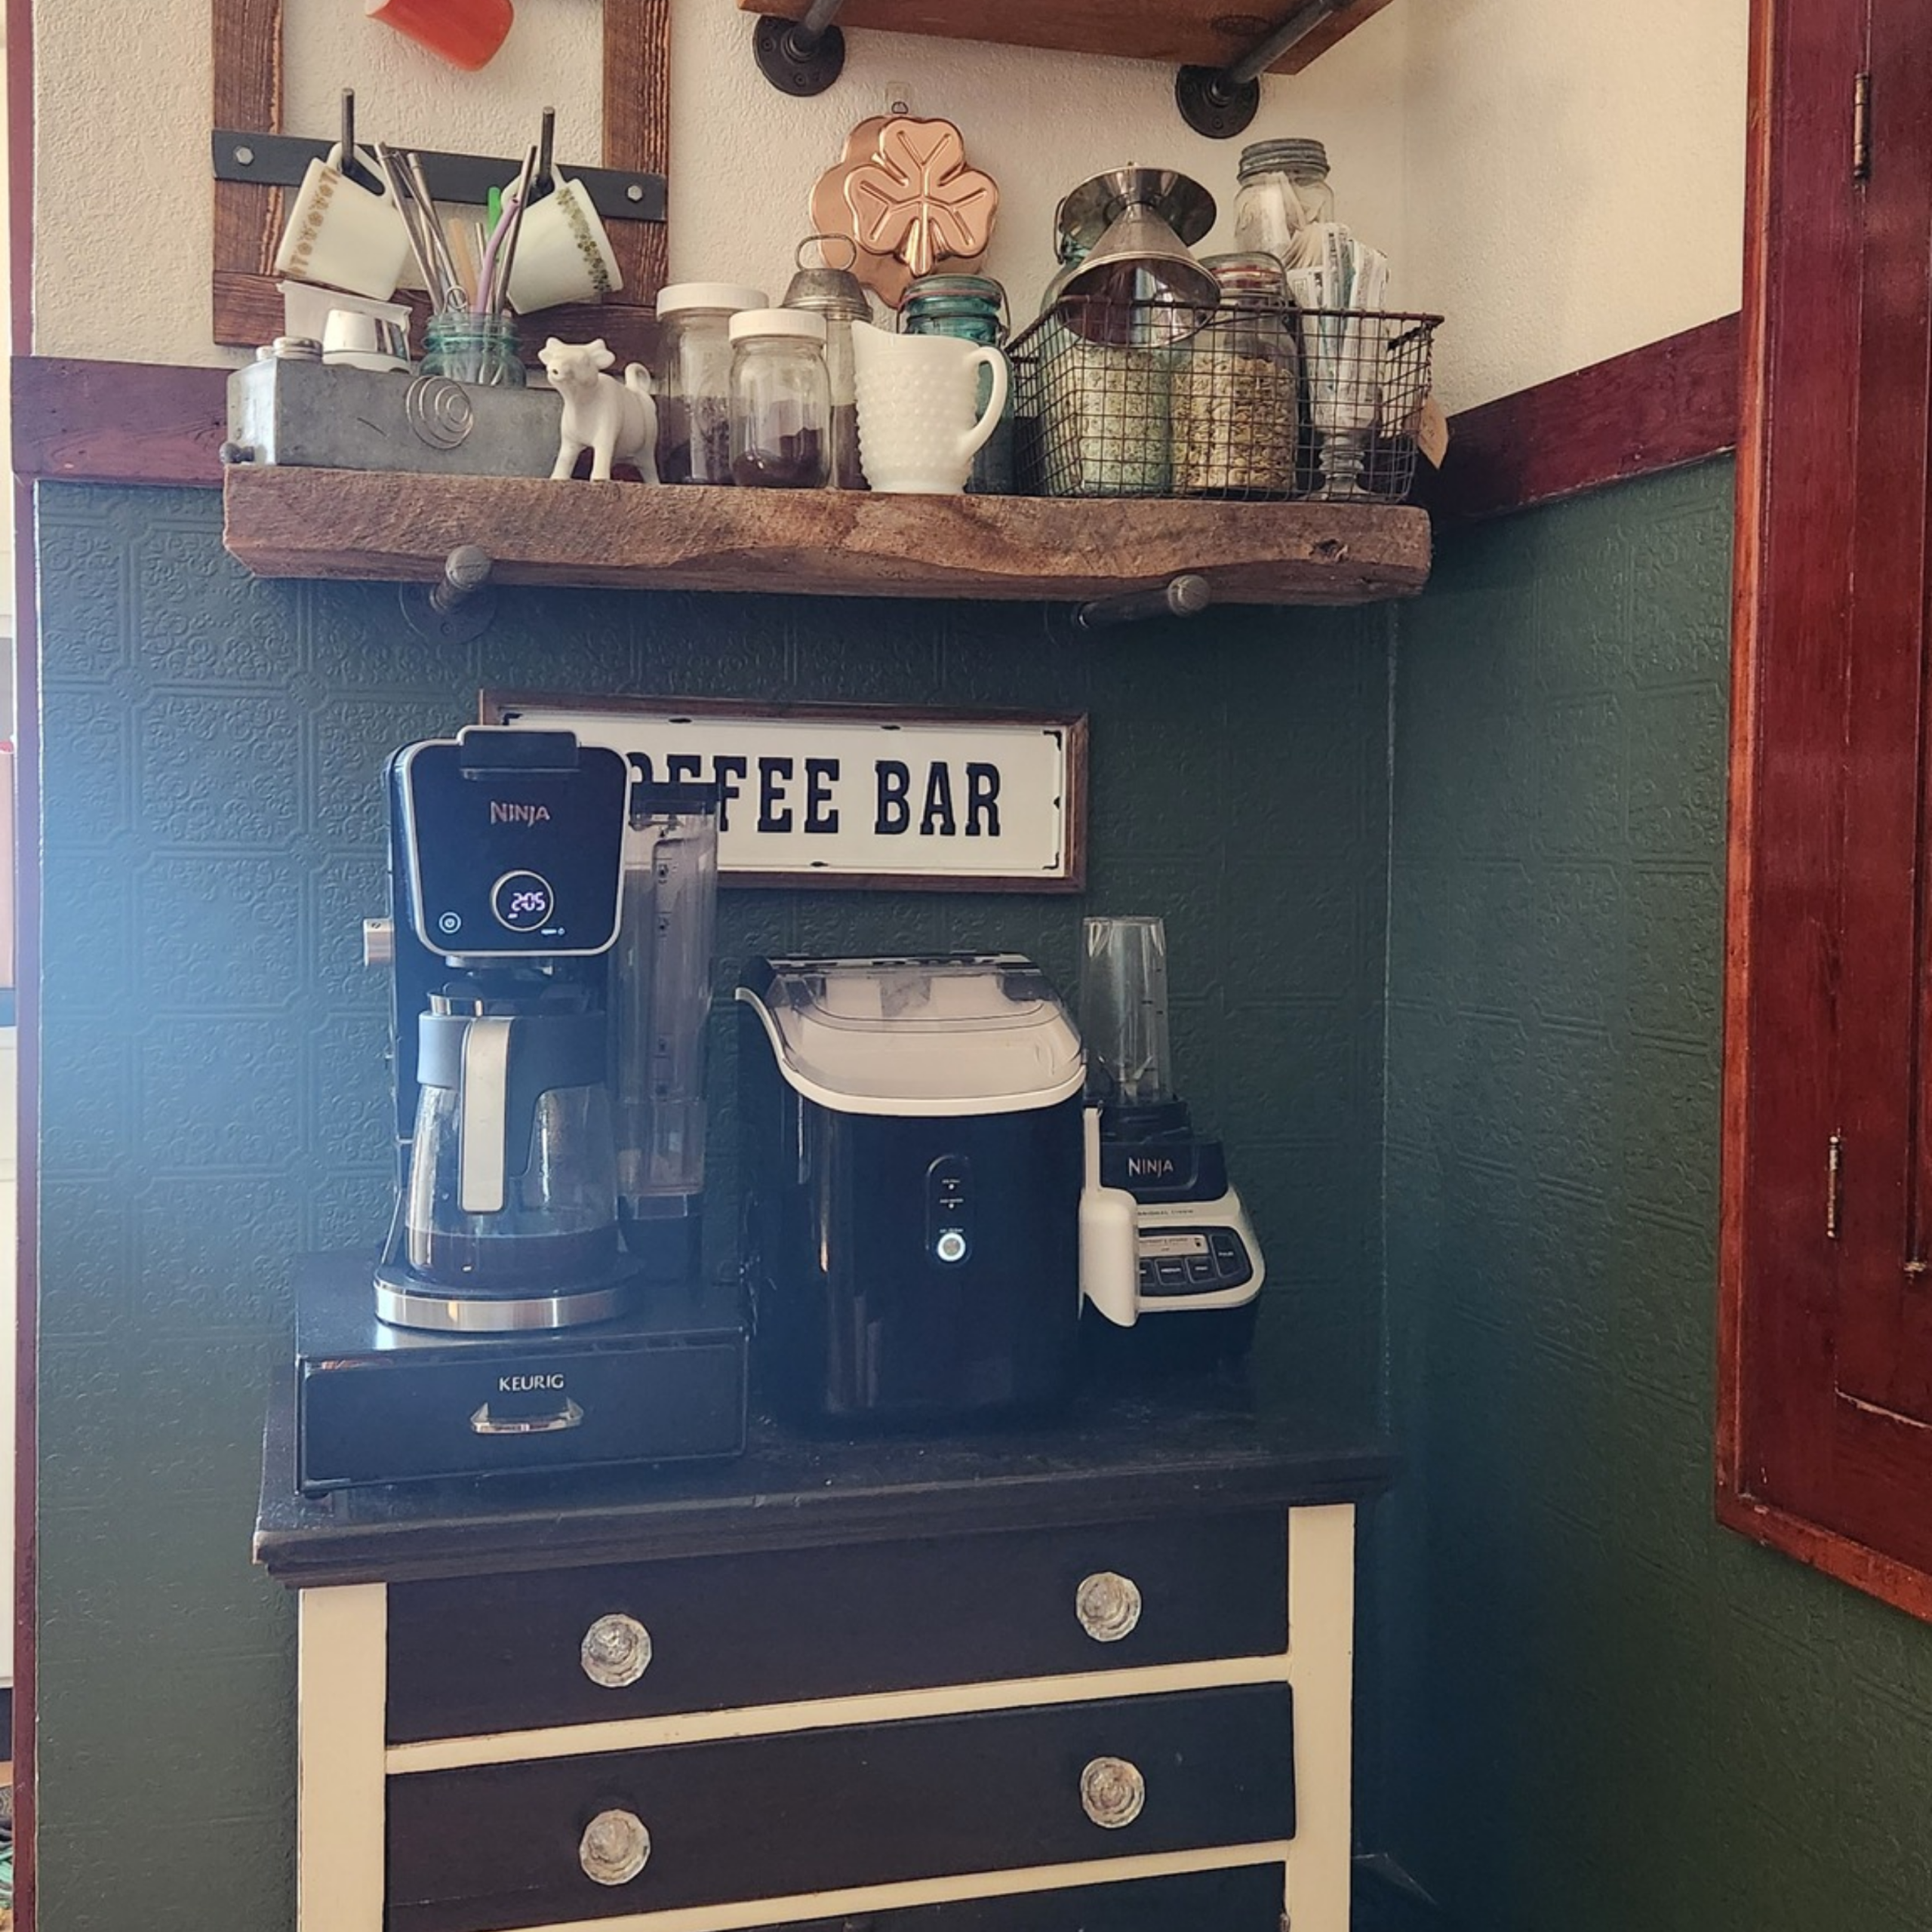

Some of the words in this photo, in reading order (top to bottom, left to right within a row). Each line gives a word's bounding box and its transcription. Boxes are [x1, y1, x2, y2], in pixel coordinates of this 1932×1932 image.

[874, 760, 1001, 837] BAR
[491, 801, 551, 827] NINJA
[1128, 1157, 1174, 1177] NINJA
[499, 1374, 565, 1392] KEURIG
